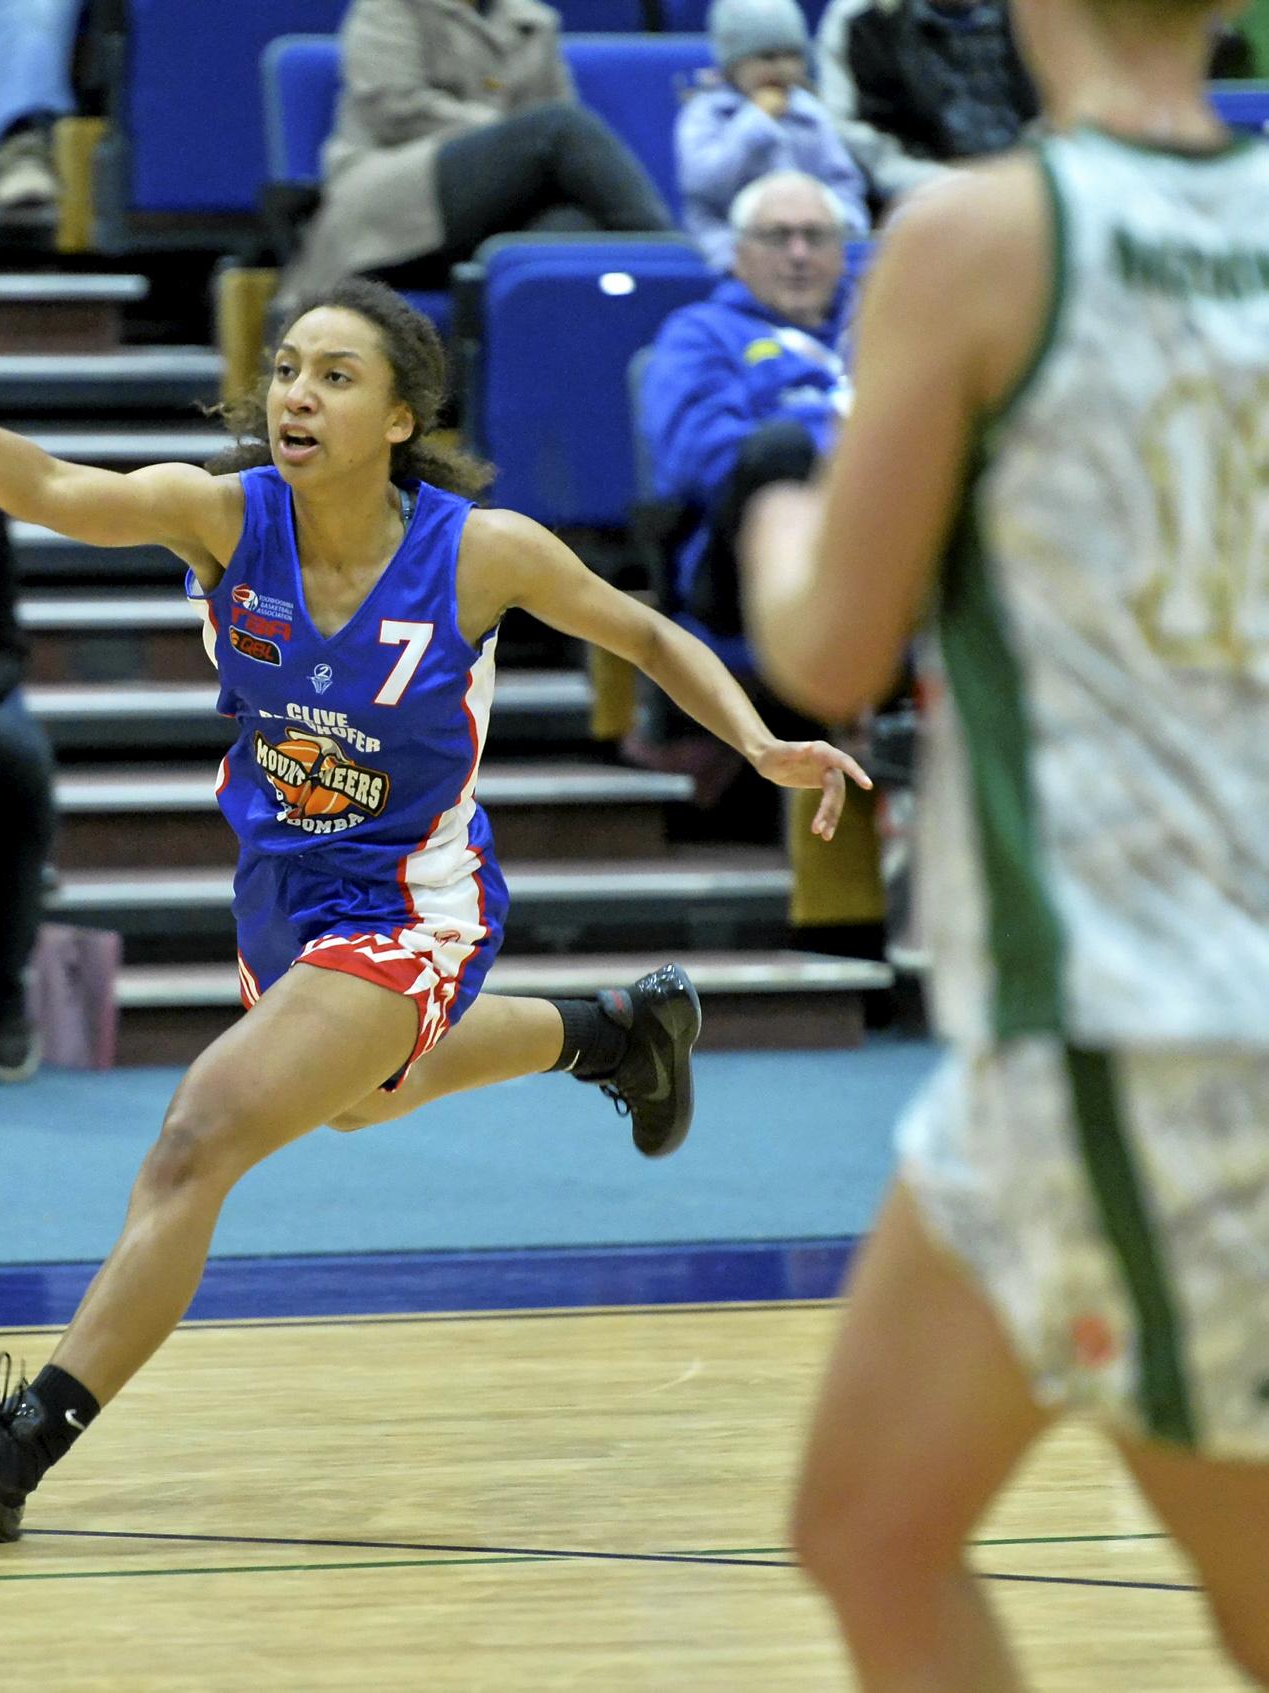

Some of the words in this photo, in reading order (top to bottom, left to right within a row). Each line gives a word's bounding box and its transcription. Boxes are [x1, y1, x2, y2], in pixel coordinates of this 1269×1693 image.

[374, 618, 435, 706] 7
[286, 702, 349, 728] CLIVE
[256, 738, 383, 810] MOUNTNEERS
